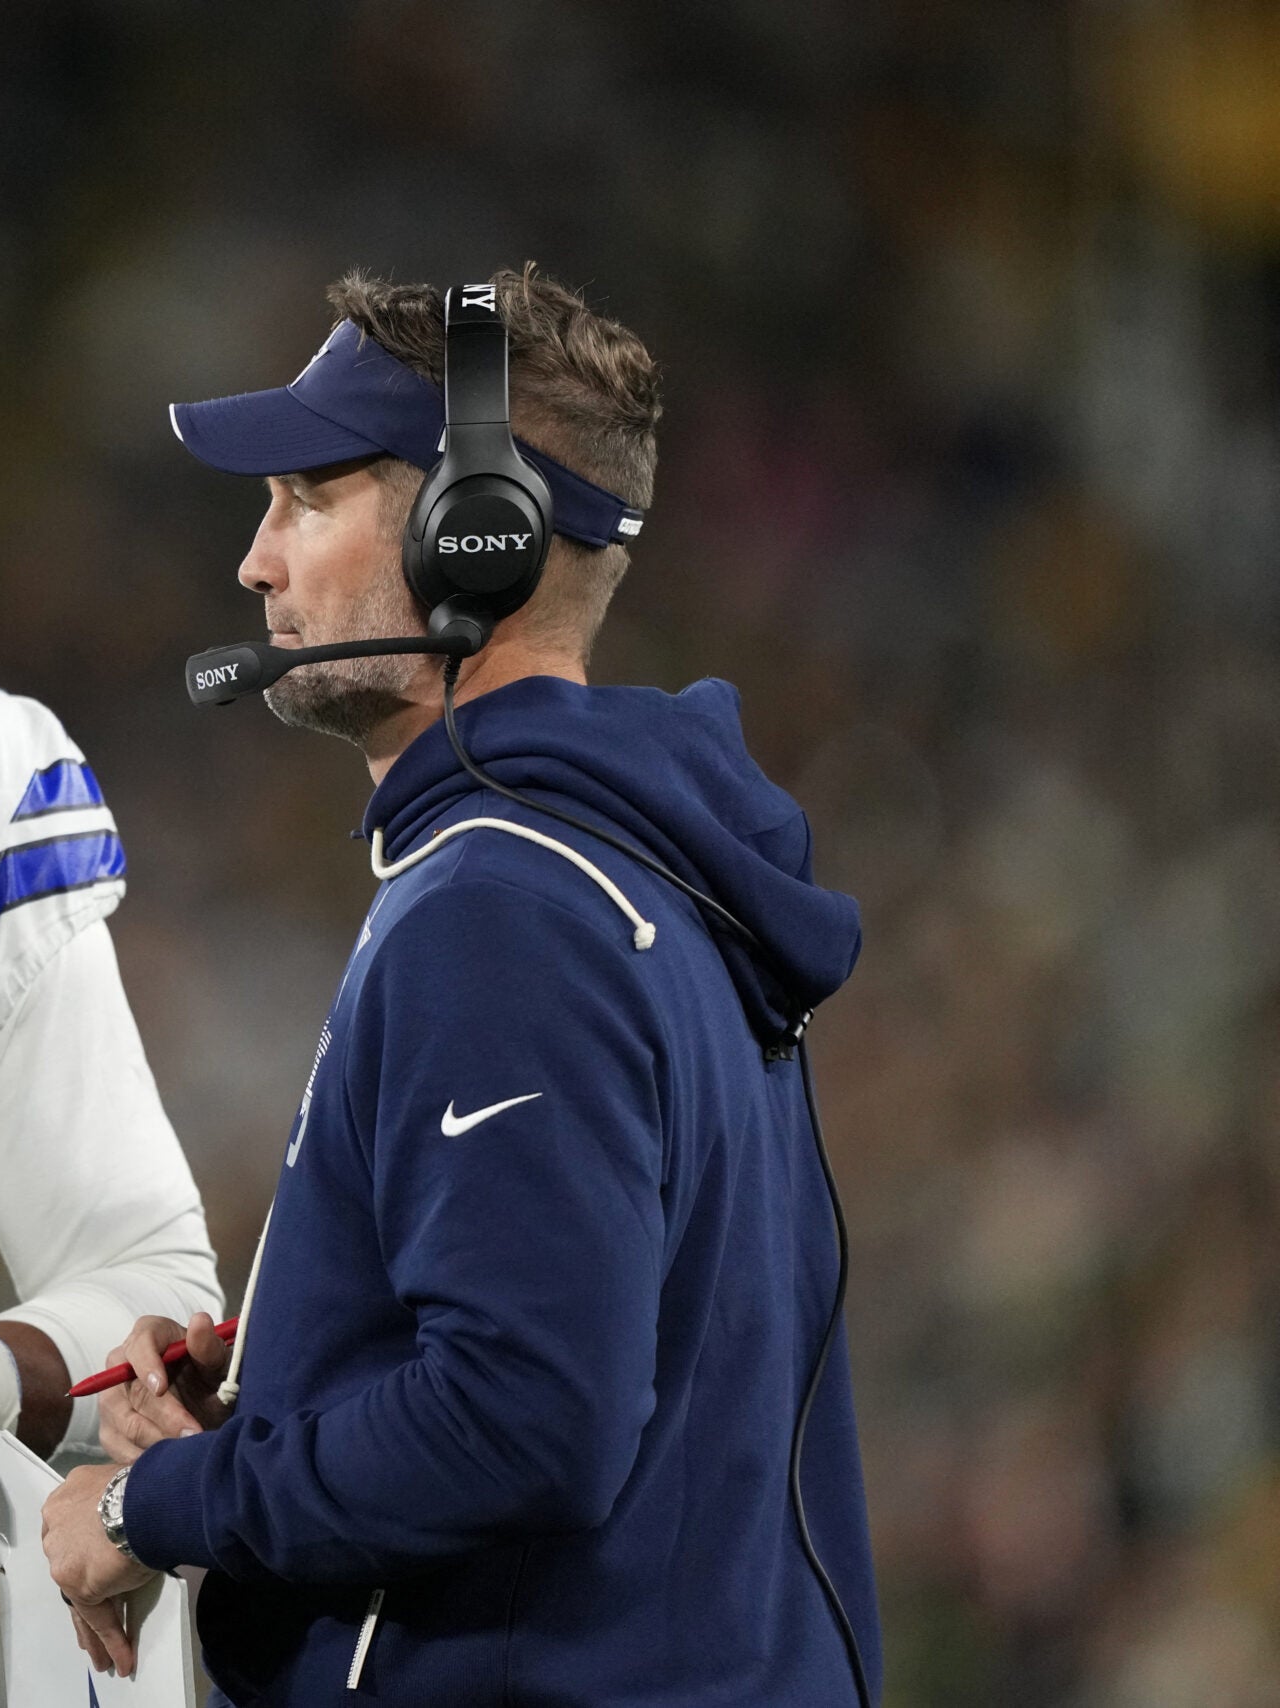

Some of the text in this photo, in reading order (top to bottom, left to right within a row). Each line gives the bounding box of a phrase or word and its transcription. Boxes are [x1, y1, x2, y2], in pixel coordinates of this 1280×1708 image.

[462, 284, 496, 312] NY
[438, 533, 532, 554] SONY
[196, 662, 239, 690] SONY
